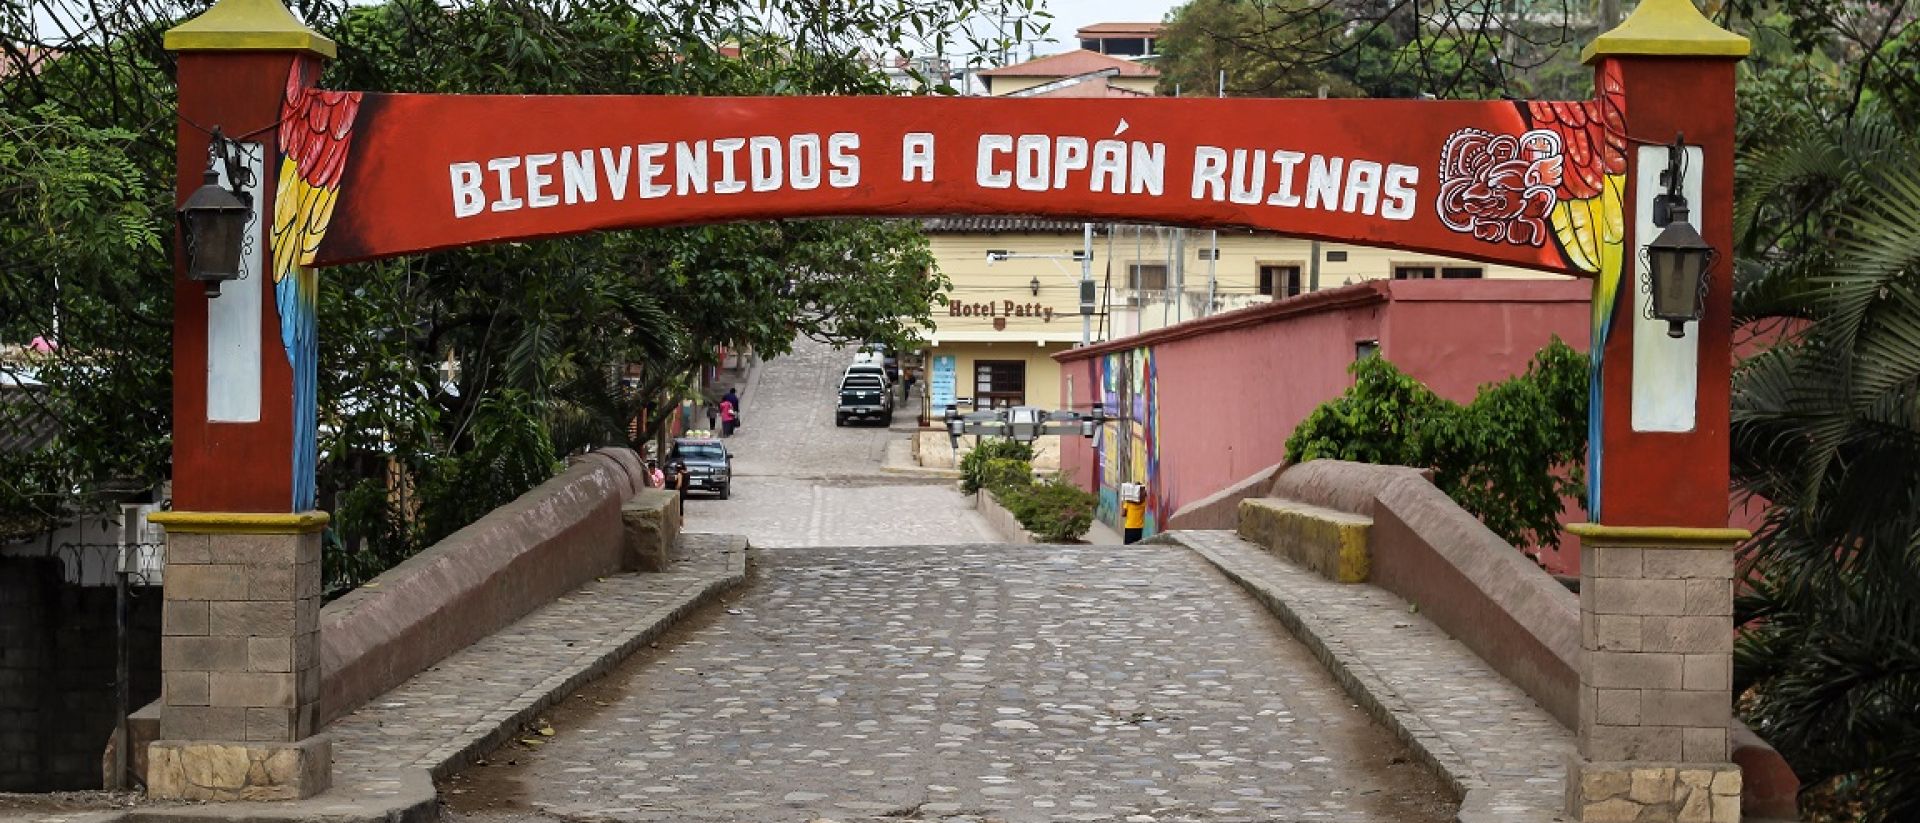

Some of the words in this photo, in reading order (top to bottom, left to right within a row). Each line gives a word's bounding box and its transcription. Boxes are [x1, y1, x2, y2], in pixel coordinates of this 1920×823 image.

[449, 131, 861, 219] BIENVENIDOS
[902, 132, 934, 182] A
[976, 117, 1166, 196] COPÁN
[1191, 145, 1419, 221] RUINAS
[949, 299, 996, 317] Hotel
[1003, 299, 1054, 323] Patty
